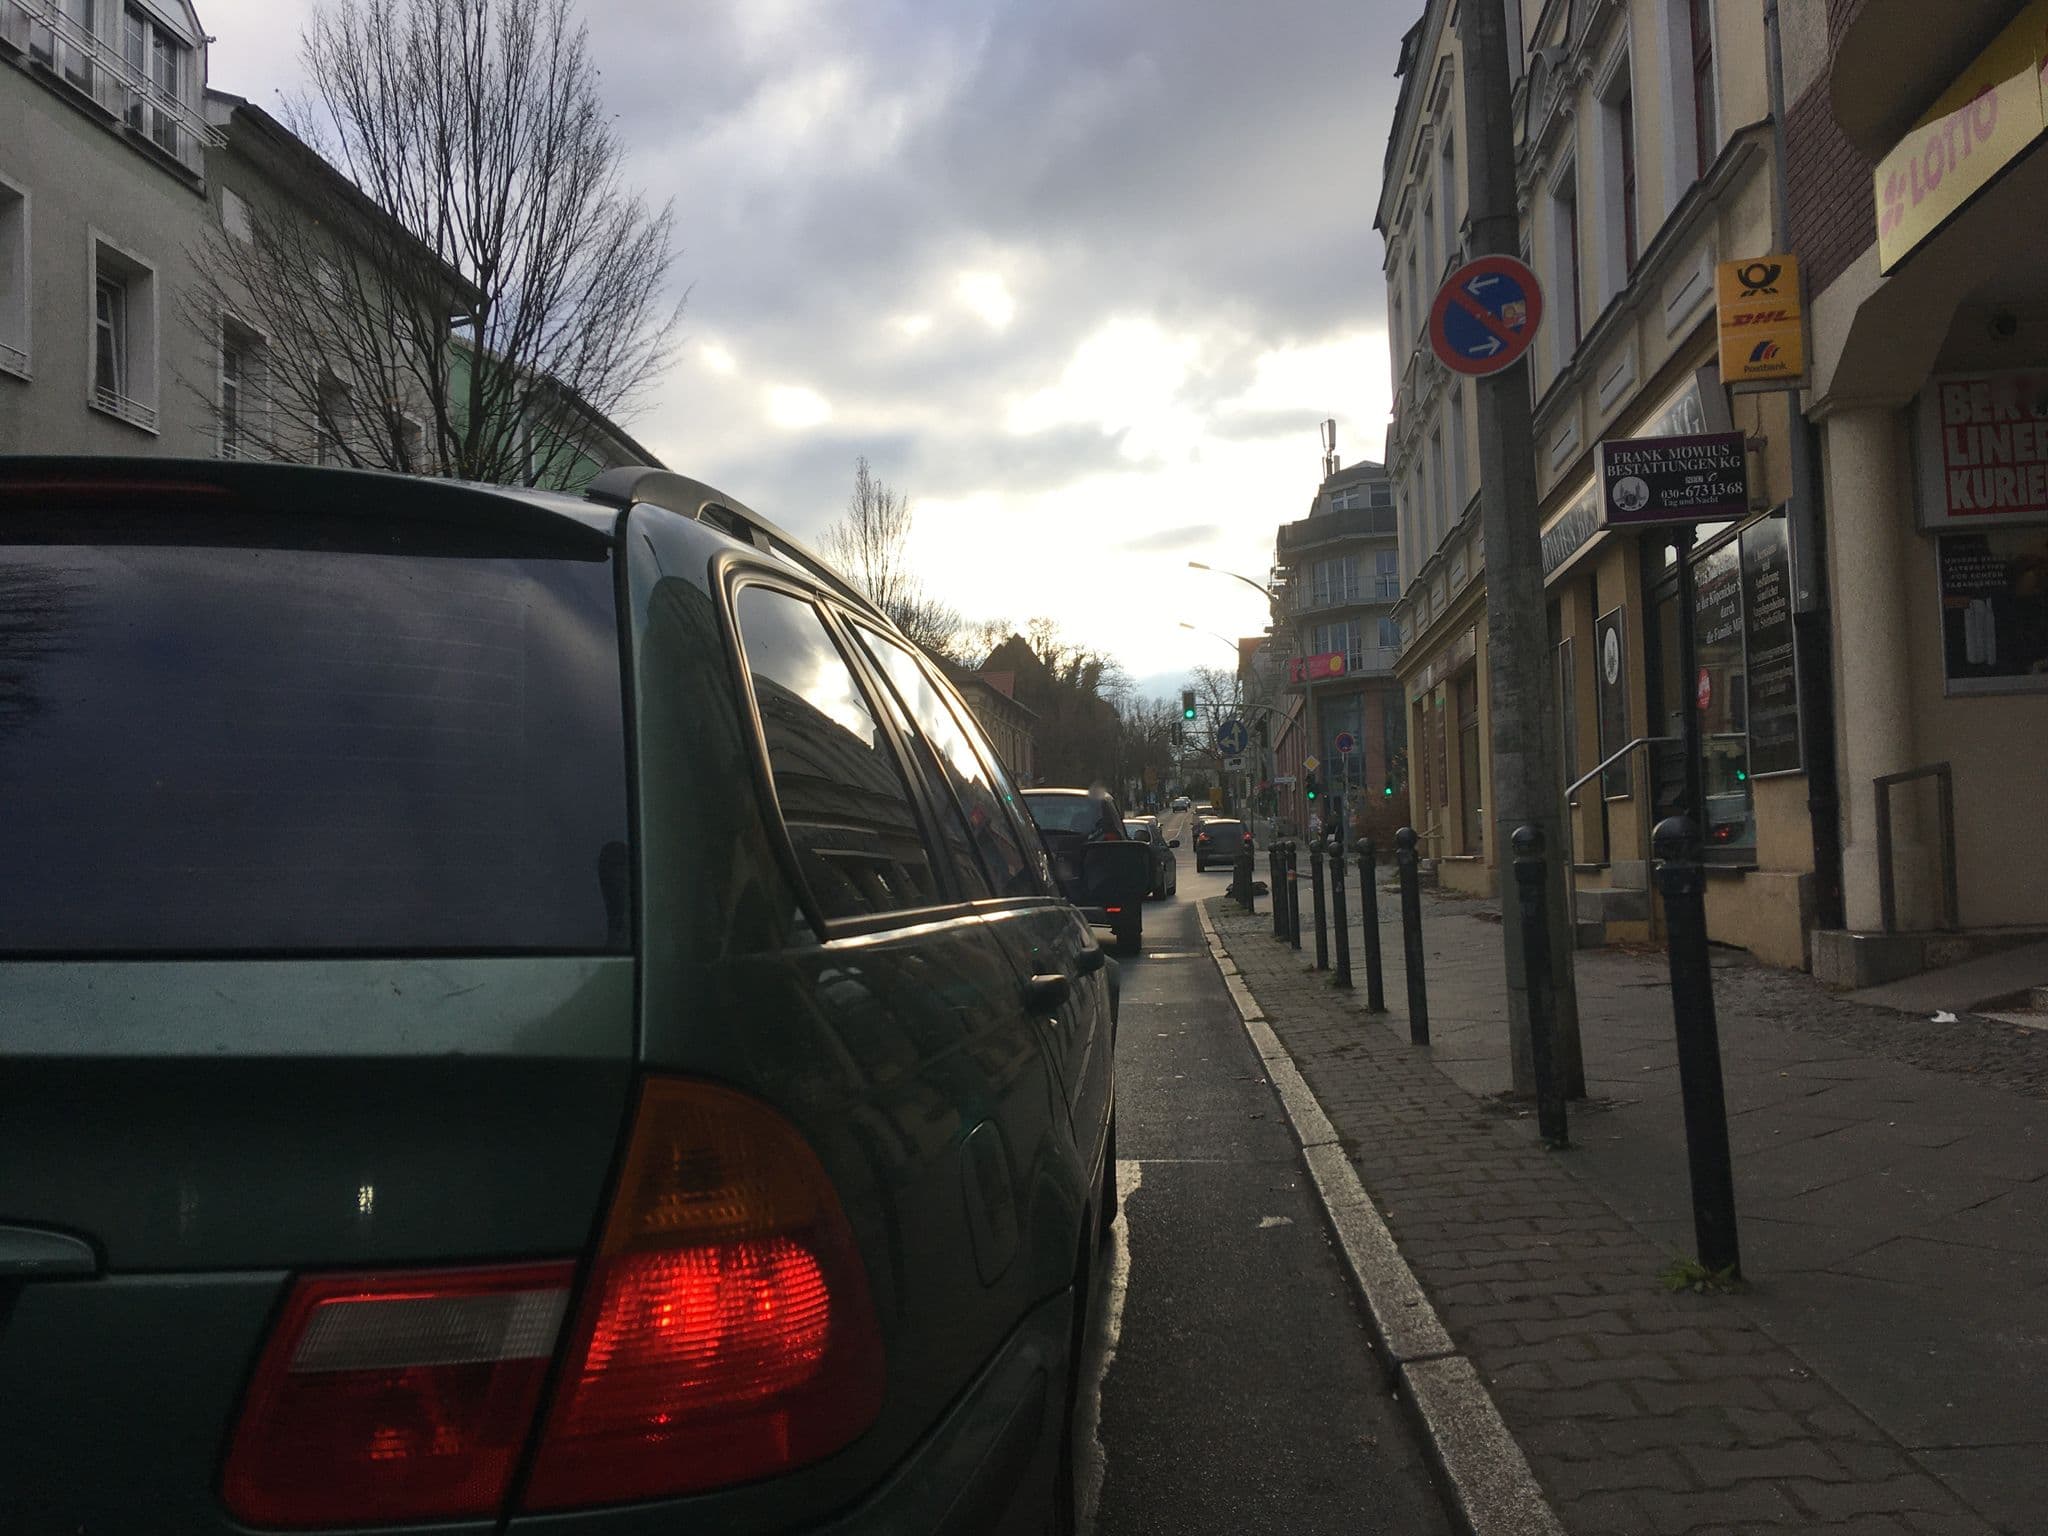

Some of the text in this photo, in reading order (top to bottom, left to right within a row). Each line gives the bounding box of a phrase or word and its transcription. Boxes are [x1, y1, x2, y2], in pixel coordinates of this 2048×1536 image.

[1910, 83, 1998, 208] LOTTO
[1732, 309, 1787, 326] DHL
[1744, 362, 1788, 374] Postbank
[1614, 448, 1663, 464] FRANK
[1607, 455, 1741, 477] BESTATTUNGEN KG
[1951, 464, 2048, 509] KURIE
[1664, 494, 1719, 508] Tag und Nacht
